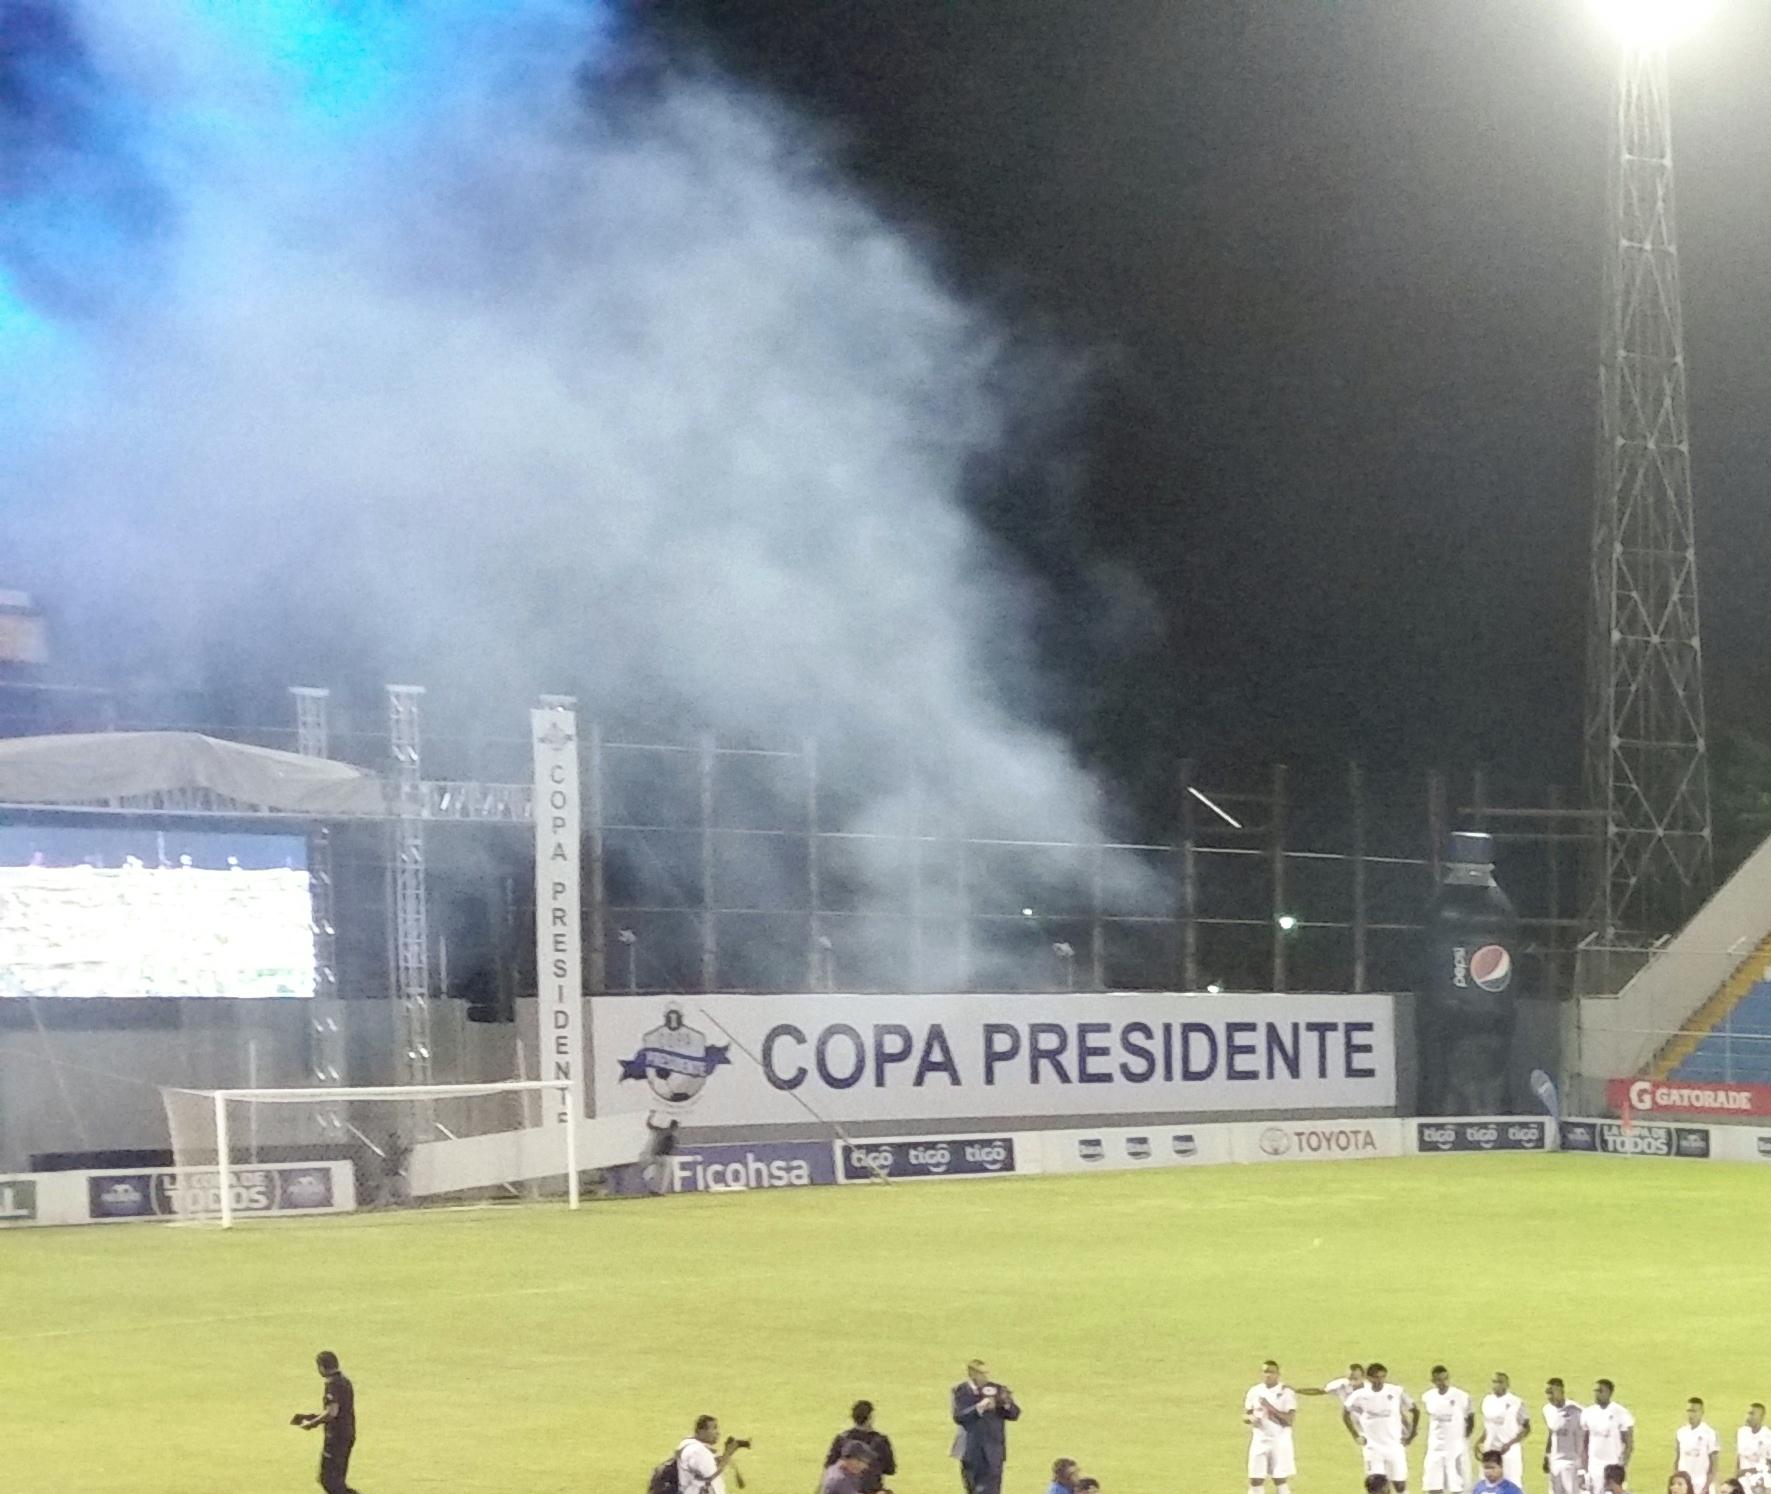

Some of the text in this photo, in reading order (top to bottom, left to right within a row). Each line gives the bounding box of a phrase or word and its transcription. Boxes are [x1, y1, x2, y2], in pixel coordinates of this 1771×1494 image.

[550, 765, 568, 861] COPA
[761, 1021, 1376, 1092] COPA PRESIDENTE
[1655, 1087, 1752, 1110] GATORADE
[1294, 1130, 1377, 1153] TOYOTA
[1604, 1137, 1668, 1155] TODOS
[672, 1153, 811, 1192] Ficohsa
